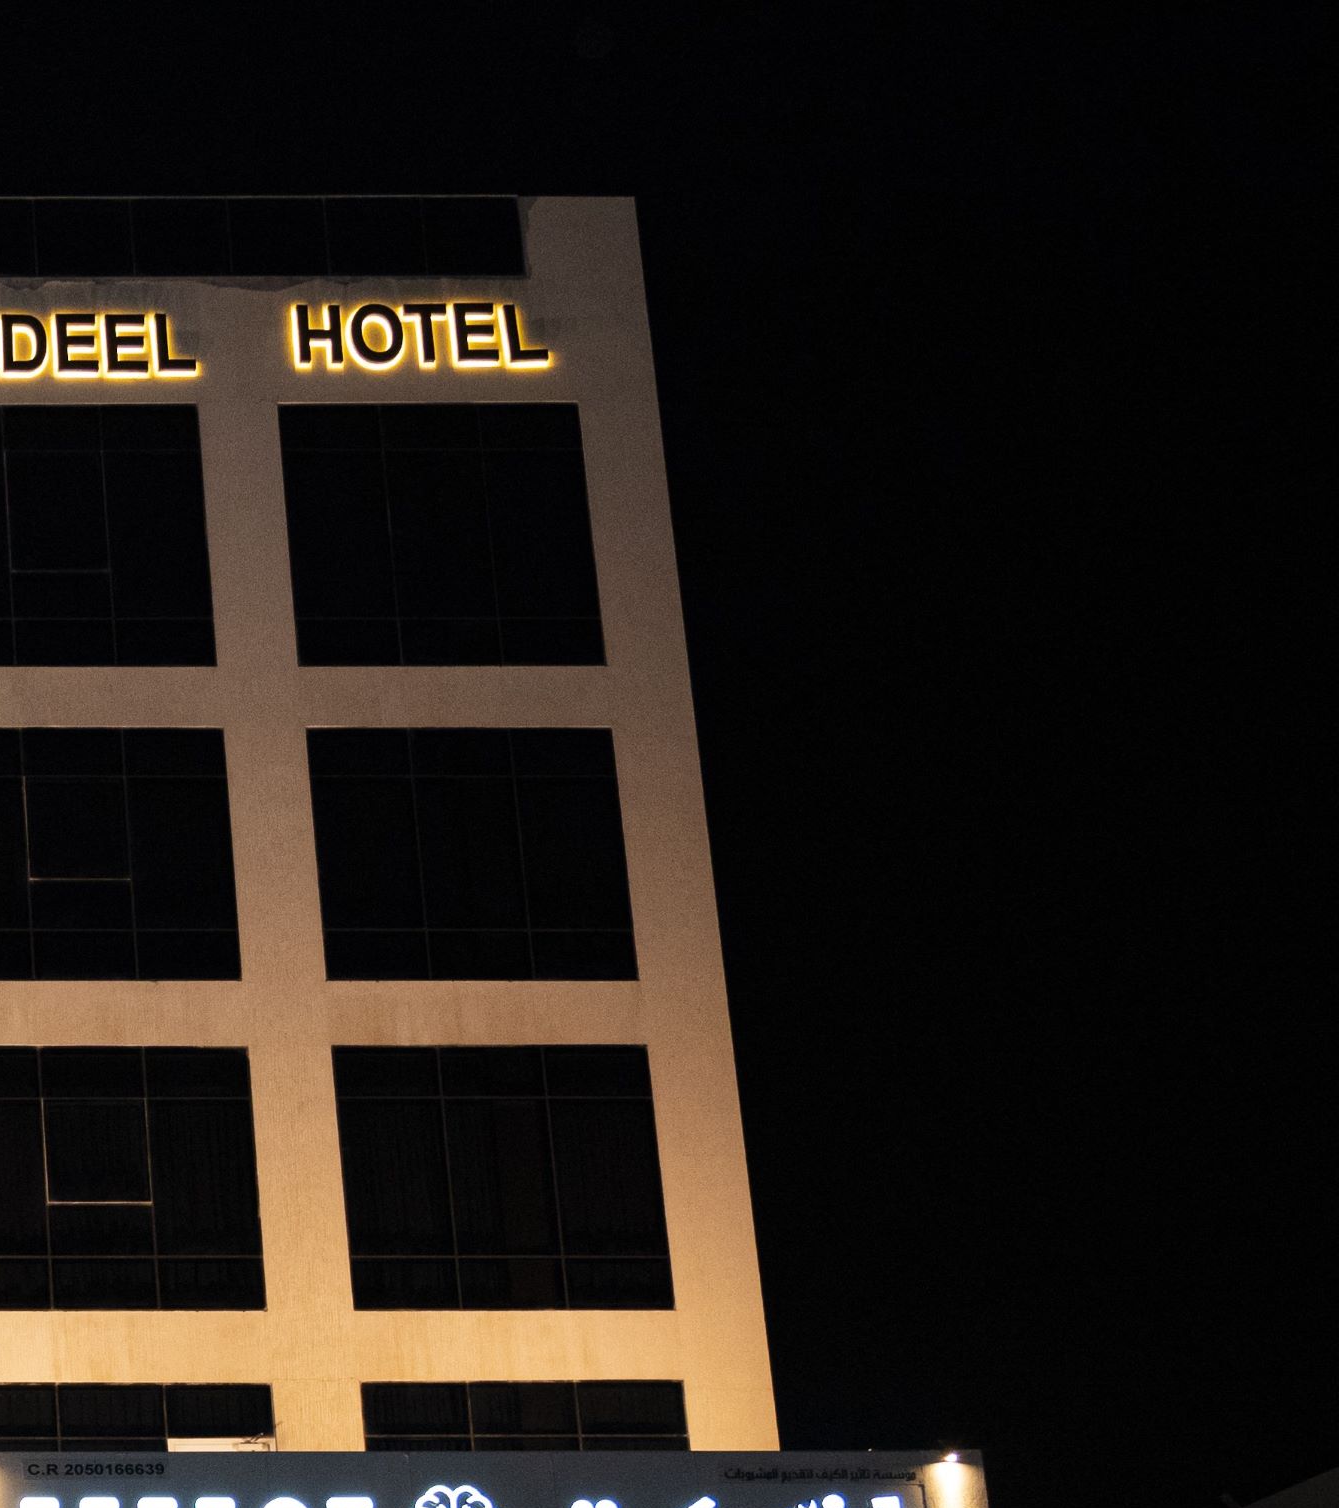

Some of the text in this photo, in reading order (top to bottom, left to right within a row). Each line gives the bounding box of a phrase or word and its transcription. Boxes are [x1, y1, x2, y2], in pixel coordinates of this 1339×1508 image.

[290, 301, 552, 369] HOTEL
[27, 1463, 166, 1476] C.R 2050166639
